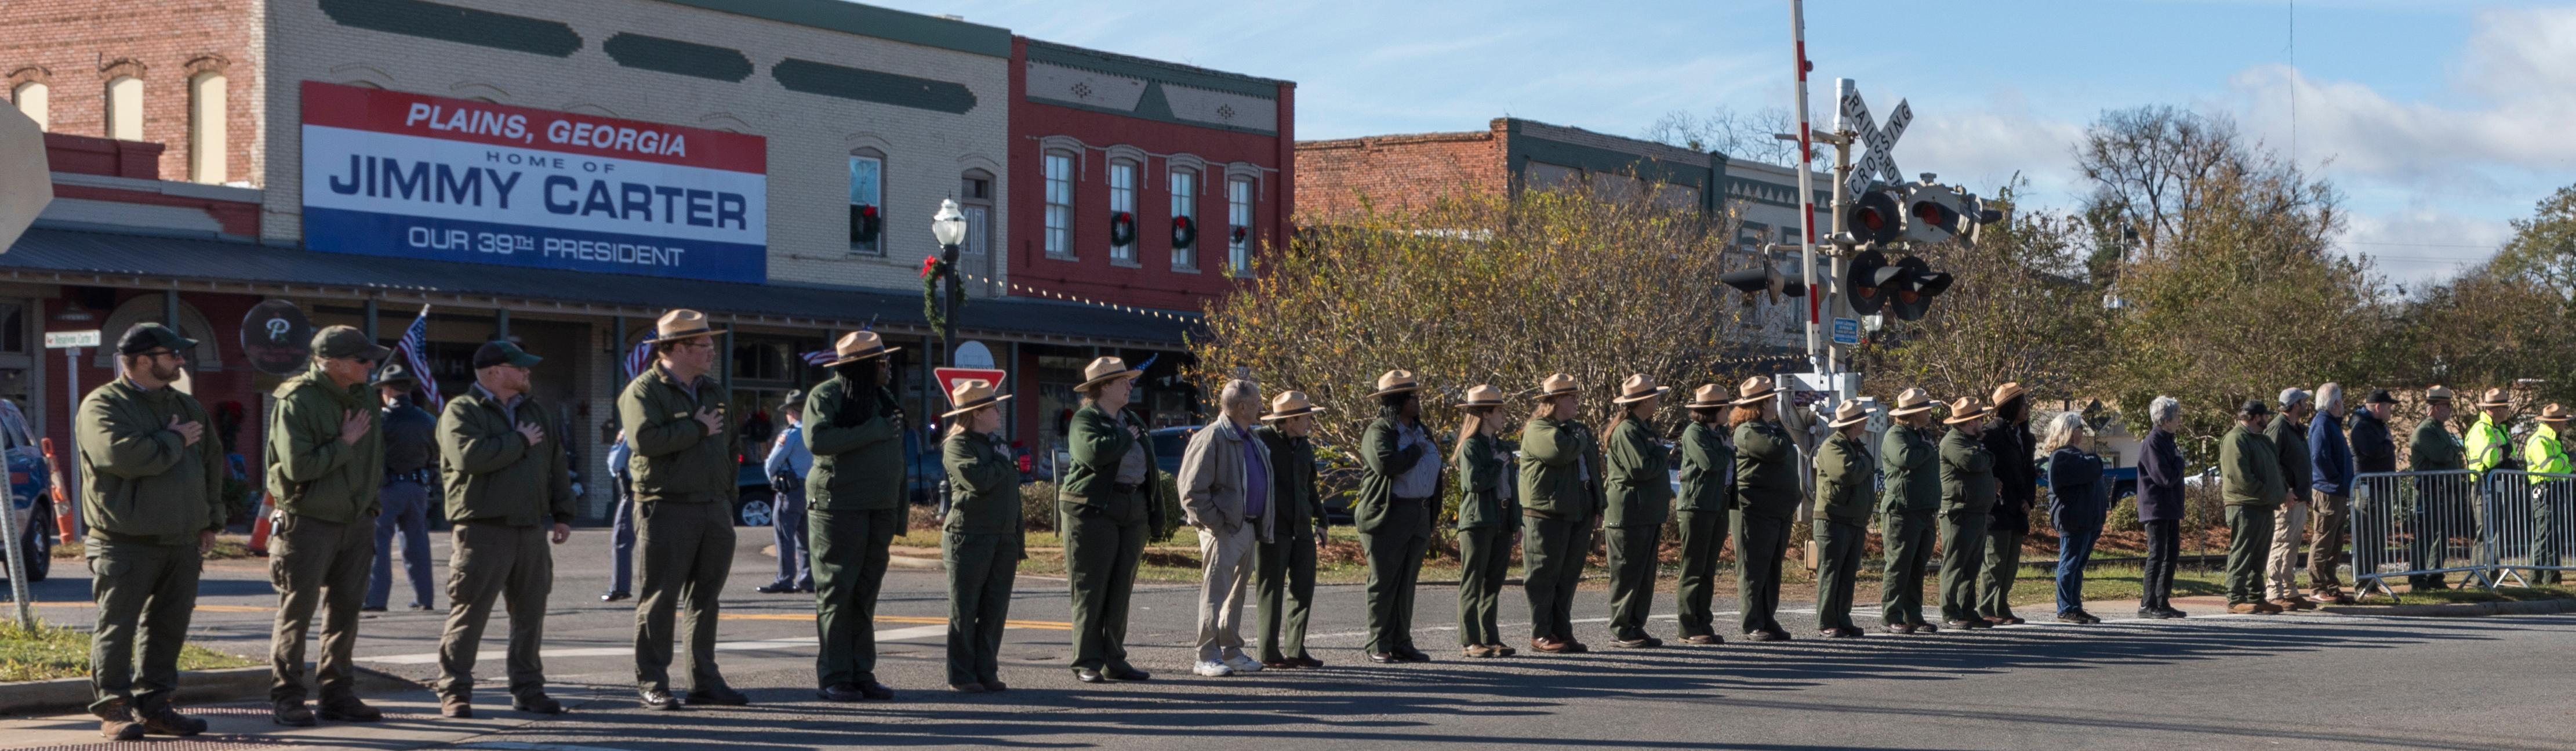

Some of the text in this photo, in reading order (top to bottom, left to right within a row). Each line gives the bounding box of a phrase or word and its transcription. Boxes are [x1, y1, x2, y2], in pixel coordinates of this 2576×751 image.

[406, 102, 686, 157] PLAINS, GEORGIA
[486, 151, 615, 173] HOME OF
[1848, 95, 1901, 188] RAIL ROA
[1851, 104, 1910, 195] CROSSING
[329, 154, 747, 230] JIMMY CARTER
[408, 227, 685, 267] OUR 39TH PRESIDENT
